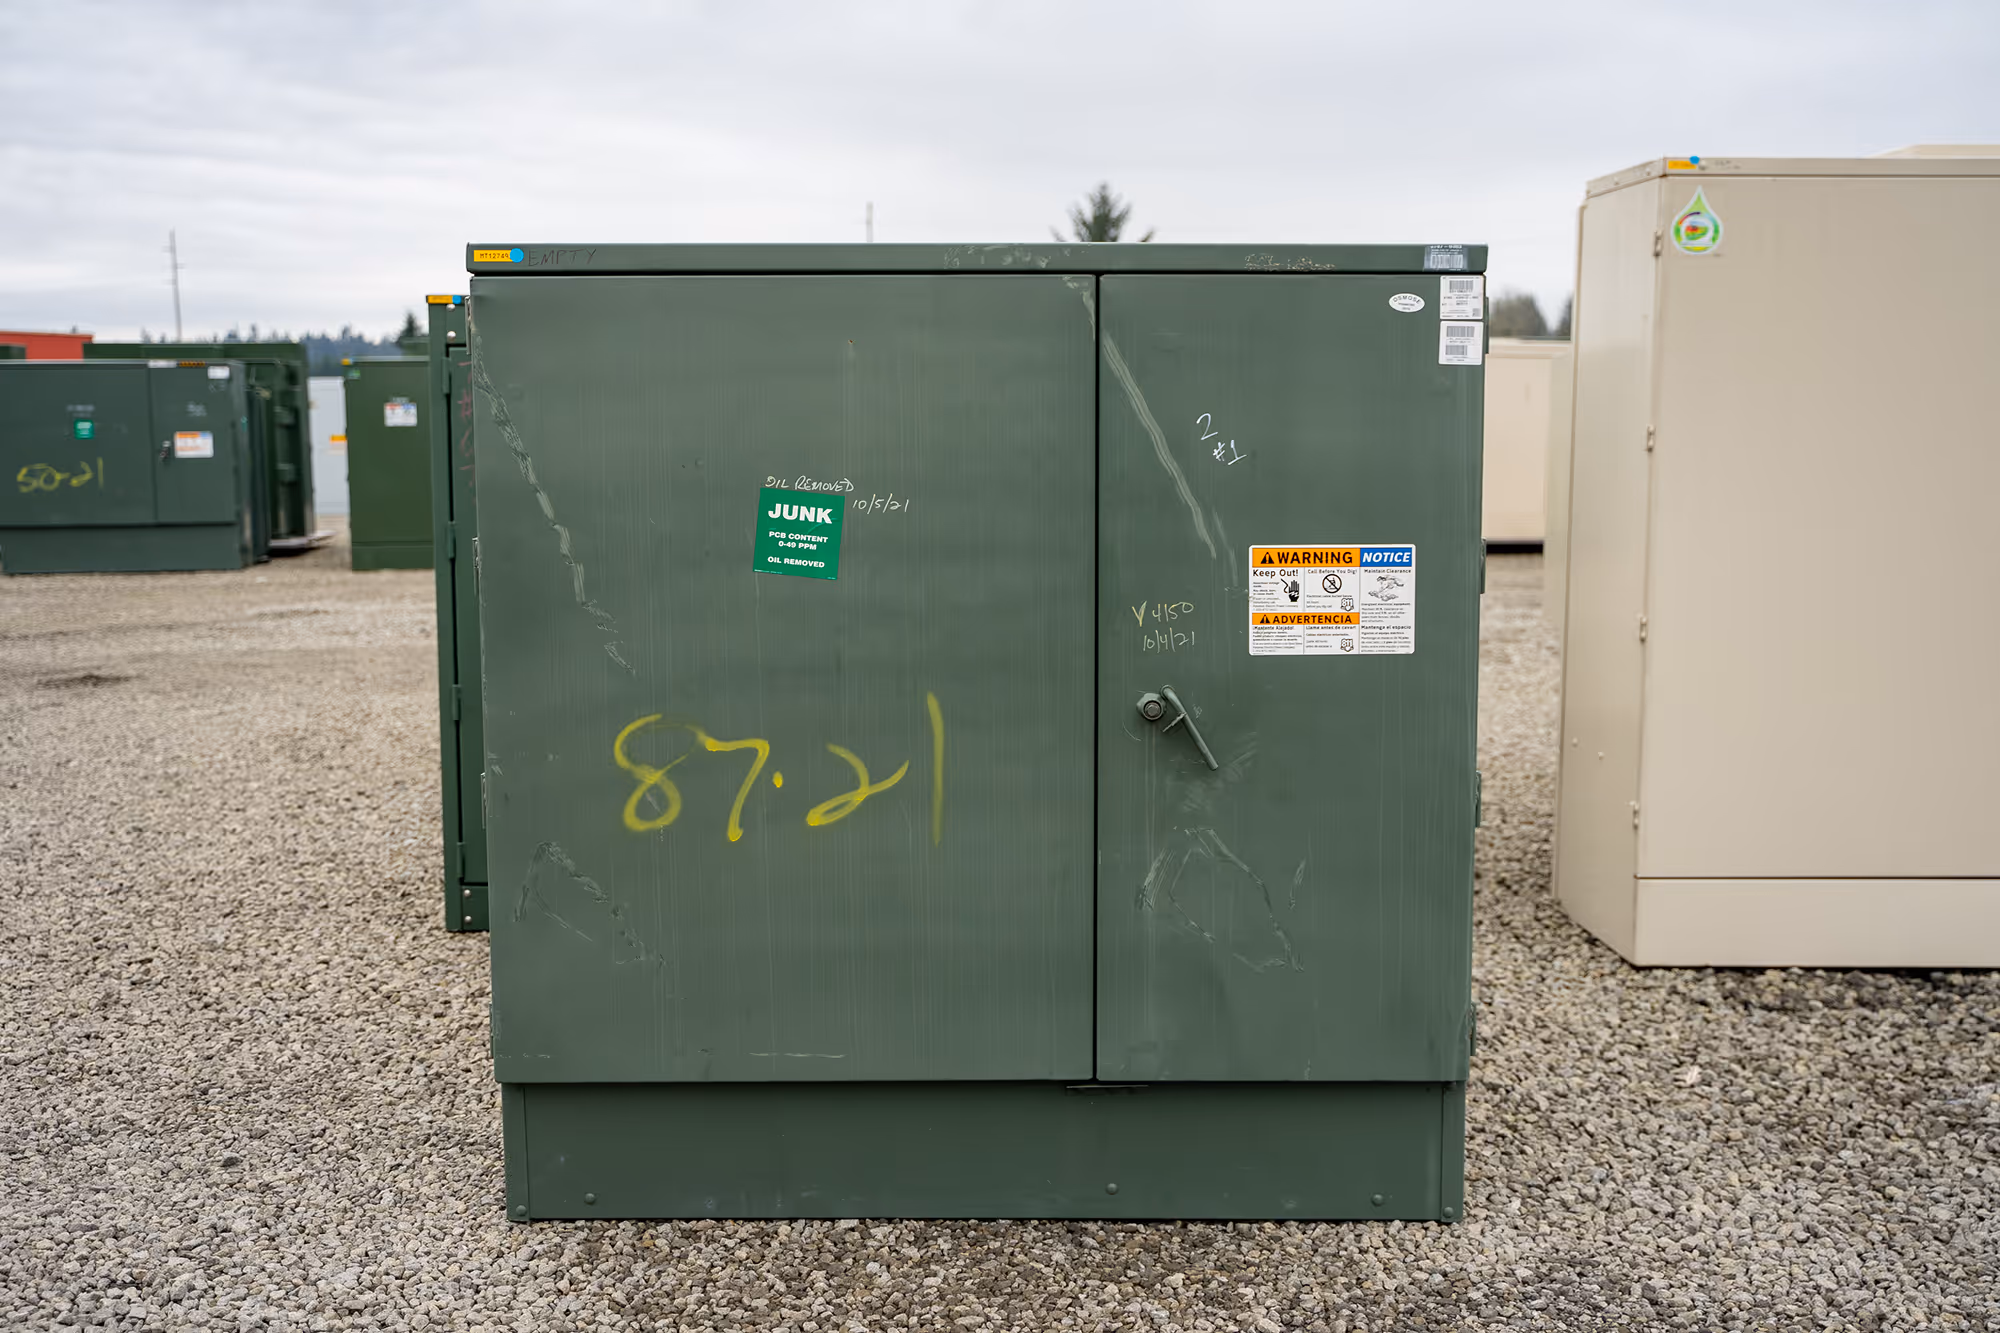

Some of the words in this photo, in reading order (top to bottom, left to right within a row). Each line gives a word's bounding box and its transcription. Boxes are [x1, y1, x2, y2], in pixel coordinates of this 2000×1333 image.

[528, 248, 597, 267] EMPTY
[1196, 413, 1218, 440] 2
[1212, 440, 1247, 465] #1
[794, 475, 855, 492] REMOVED
[852, 493, 909, 515] 10/5/21
[768, 503, 833, 524] JUNK
[768, 531, 786, 539] PCB
[788, 532, 829, 543] CONTENT
[778, 540, 797, 549] 0-49
[798, 542, 817, 550] PPM
[767, 556, 782, 564] OIL
[783, 557, 825, 568] REMOVED
[1277, 551, 1353, 565] WARNING
[1362, 552, 1411, 563] NOTICE
[1252, 569, 1276, 579] Keep
[1279, 569, 1299, 577] Out!
[1341, 598, 1353, 607] 811
[1152, 602, 1195, 622] 4150
[1272, 615, 1353, 624] ADVERTENCIA
[1142, 627, 1195, 653] 10/4/21
[613, 691, 944, 848] 87.21
